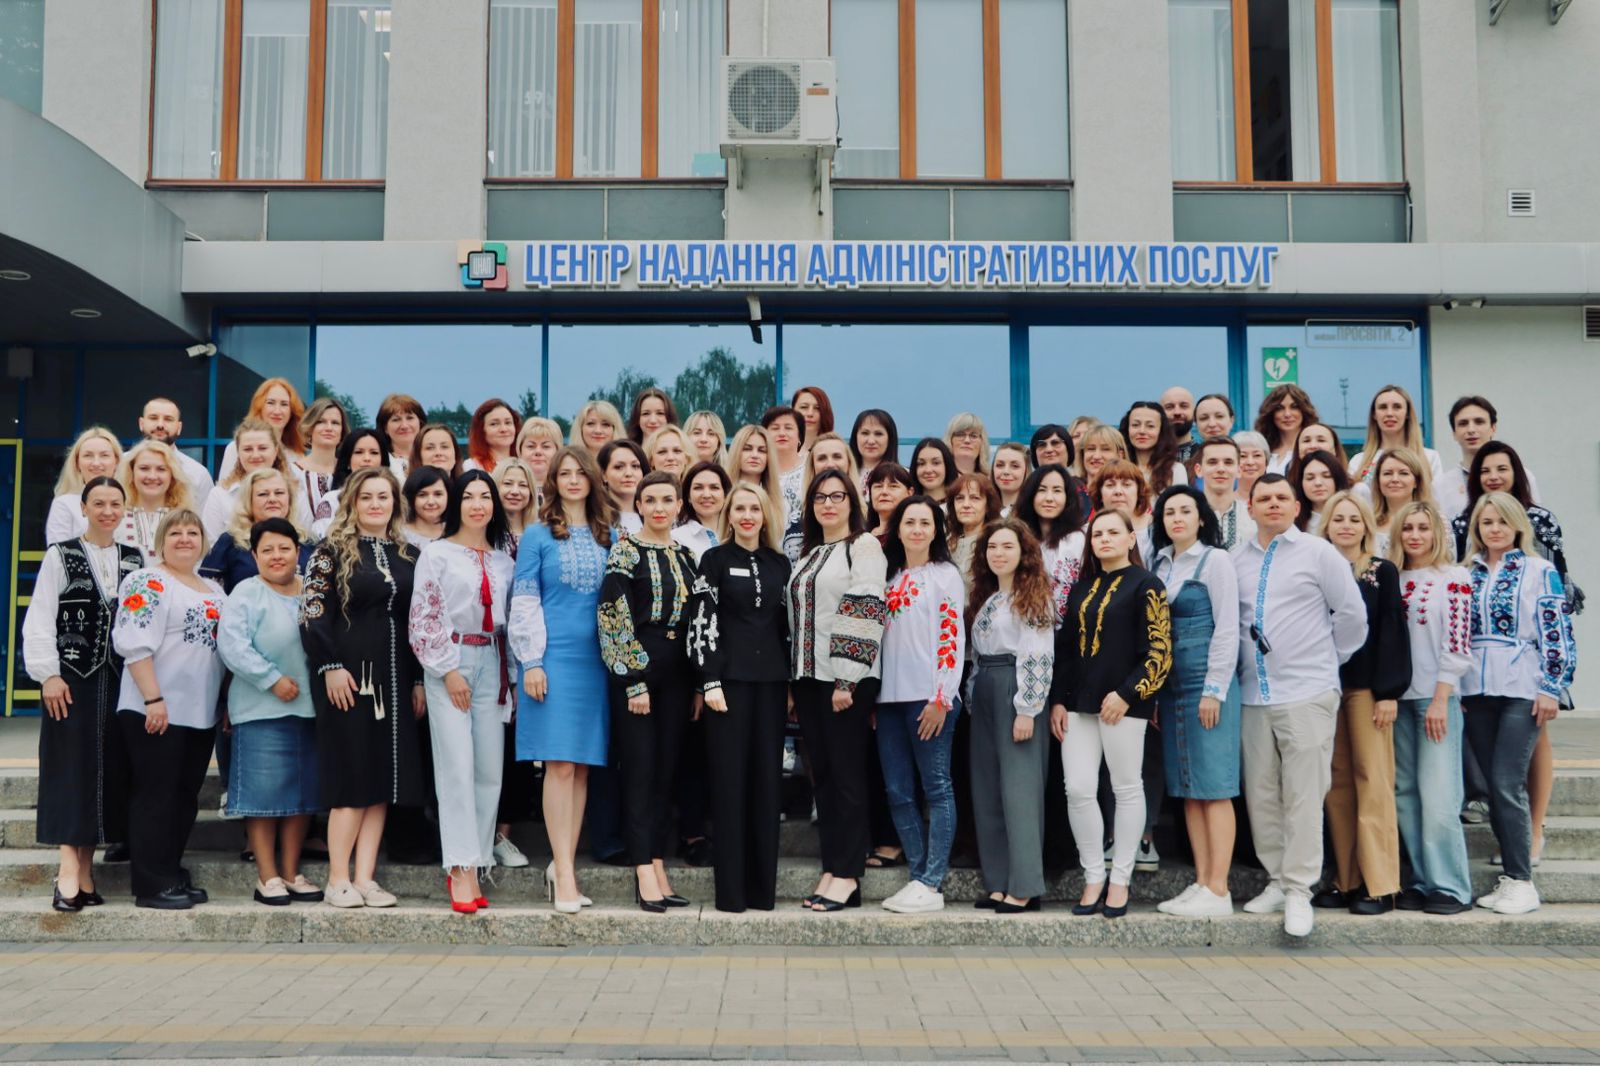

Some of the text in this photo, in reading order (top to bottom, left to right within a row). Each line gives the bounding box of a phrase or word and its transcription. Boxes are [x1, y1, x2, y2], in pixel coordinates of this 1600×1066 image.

[524, 243, 1280, 287] ЦЕНТР НАДАННЯ АДМІНІСТРАТИВНИХ ПОСЛУГ
